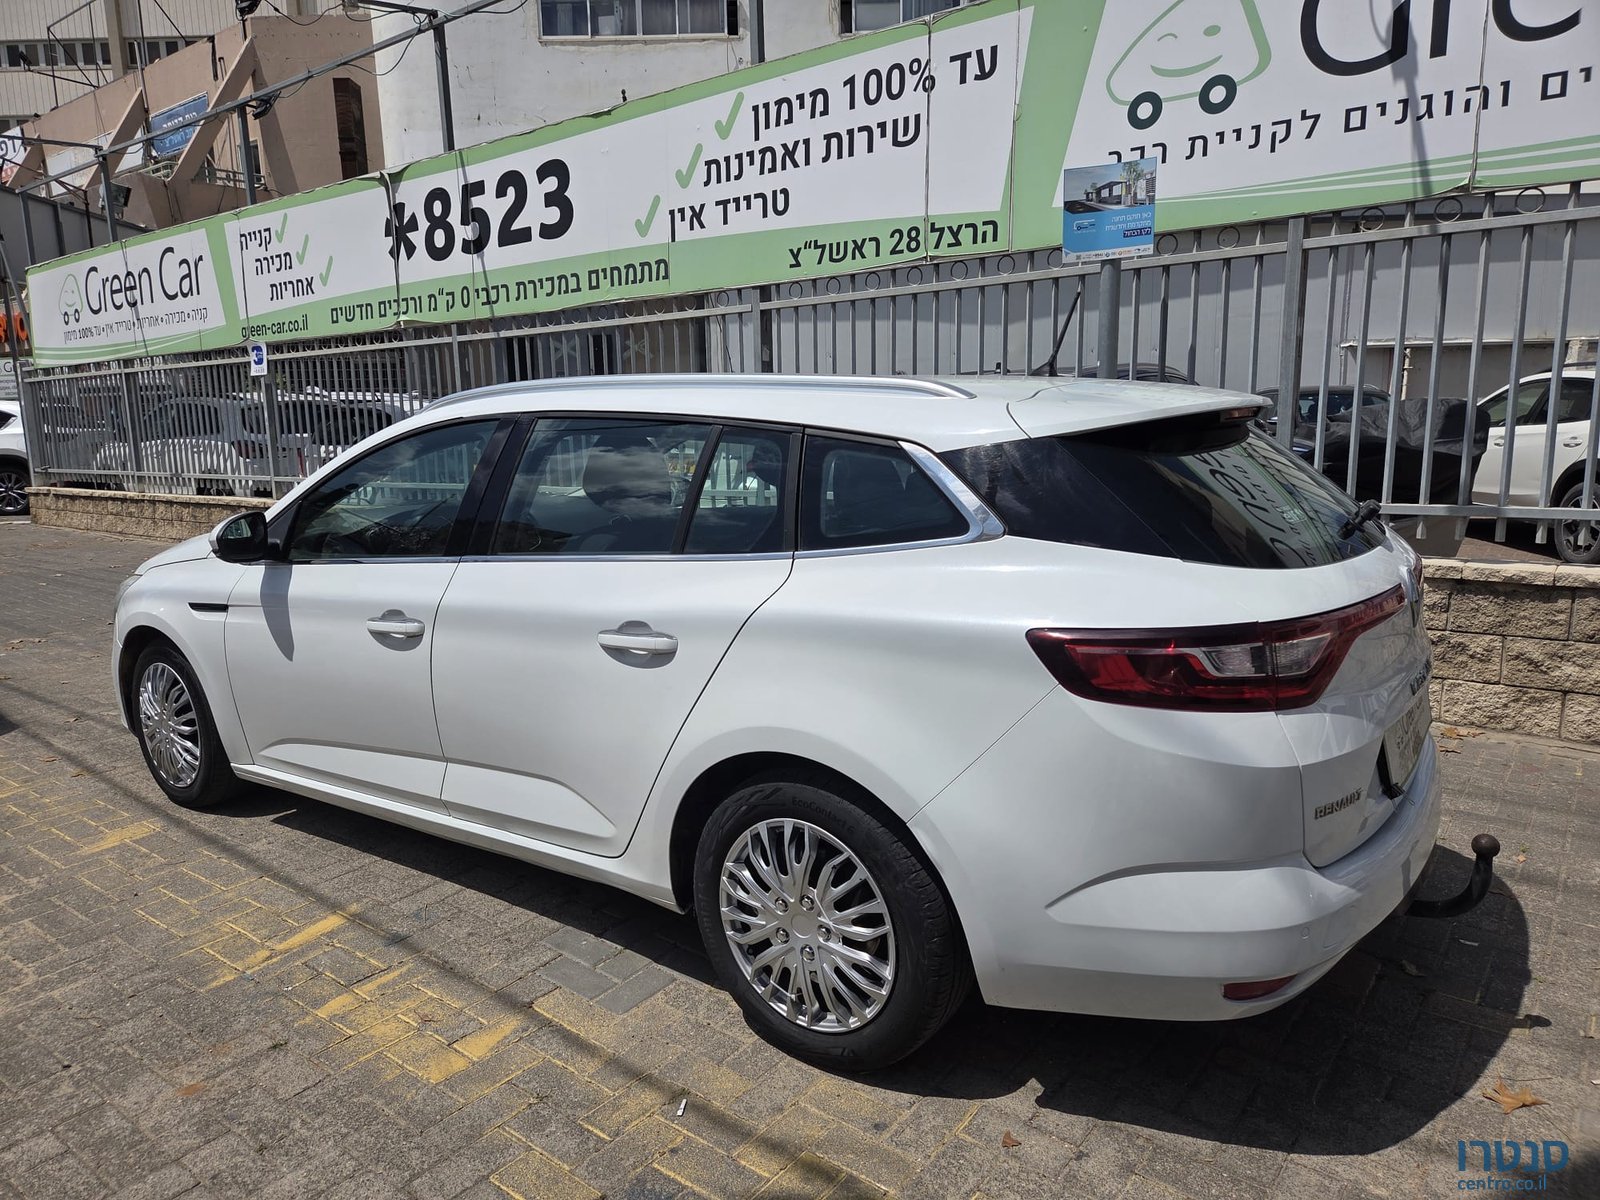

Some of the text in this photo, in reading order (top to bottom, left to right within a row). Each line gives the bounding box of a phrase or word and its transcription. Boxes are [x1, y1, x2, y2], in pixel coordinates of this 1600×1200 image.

[752, 45, 998, 141] עד 100% מימון
[1344, 80, 1511, 133] והוגנים
[703, 113, 921, 187] שירות ואמינות
[1185, 109, 1321, 161] לקניית
[668, 187, 790, 243] טרייד אין
[888, 225, 921, 257] 28
[929, 220, 999, 250] הרצל
[255, 251, 293, 276] מכירה
[588, 258, 670, 291] מתמחים
[85, 246, 203, 316] Green Car
[269, 276, 316, 302] אחריות
[474, 283, 511, 306] רכבי
[515, 272, 582, 301] במכירת
[378, 295, 423, 319] ורכבים
[461, 285, 471, 308] 0
[241, 313, 309, 339] geen-car.co.il
[330, 301, 374, 324] חדשים
